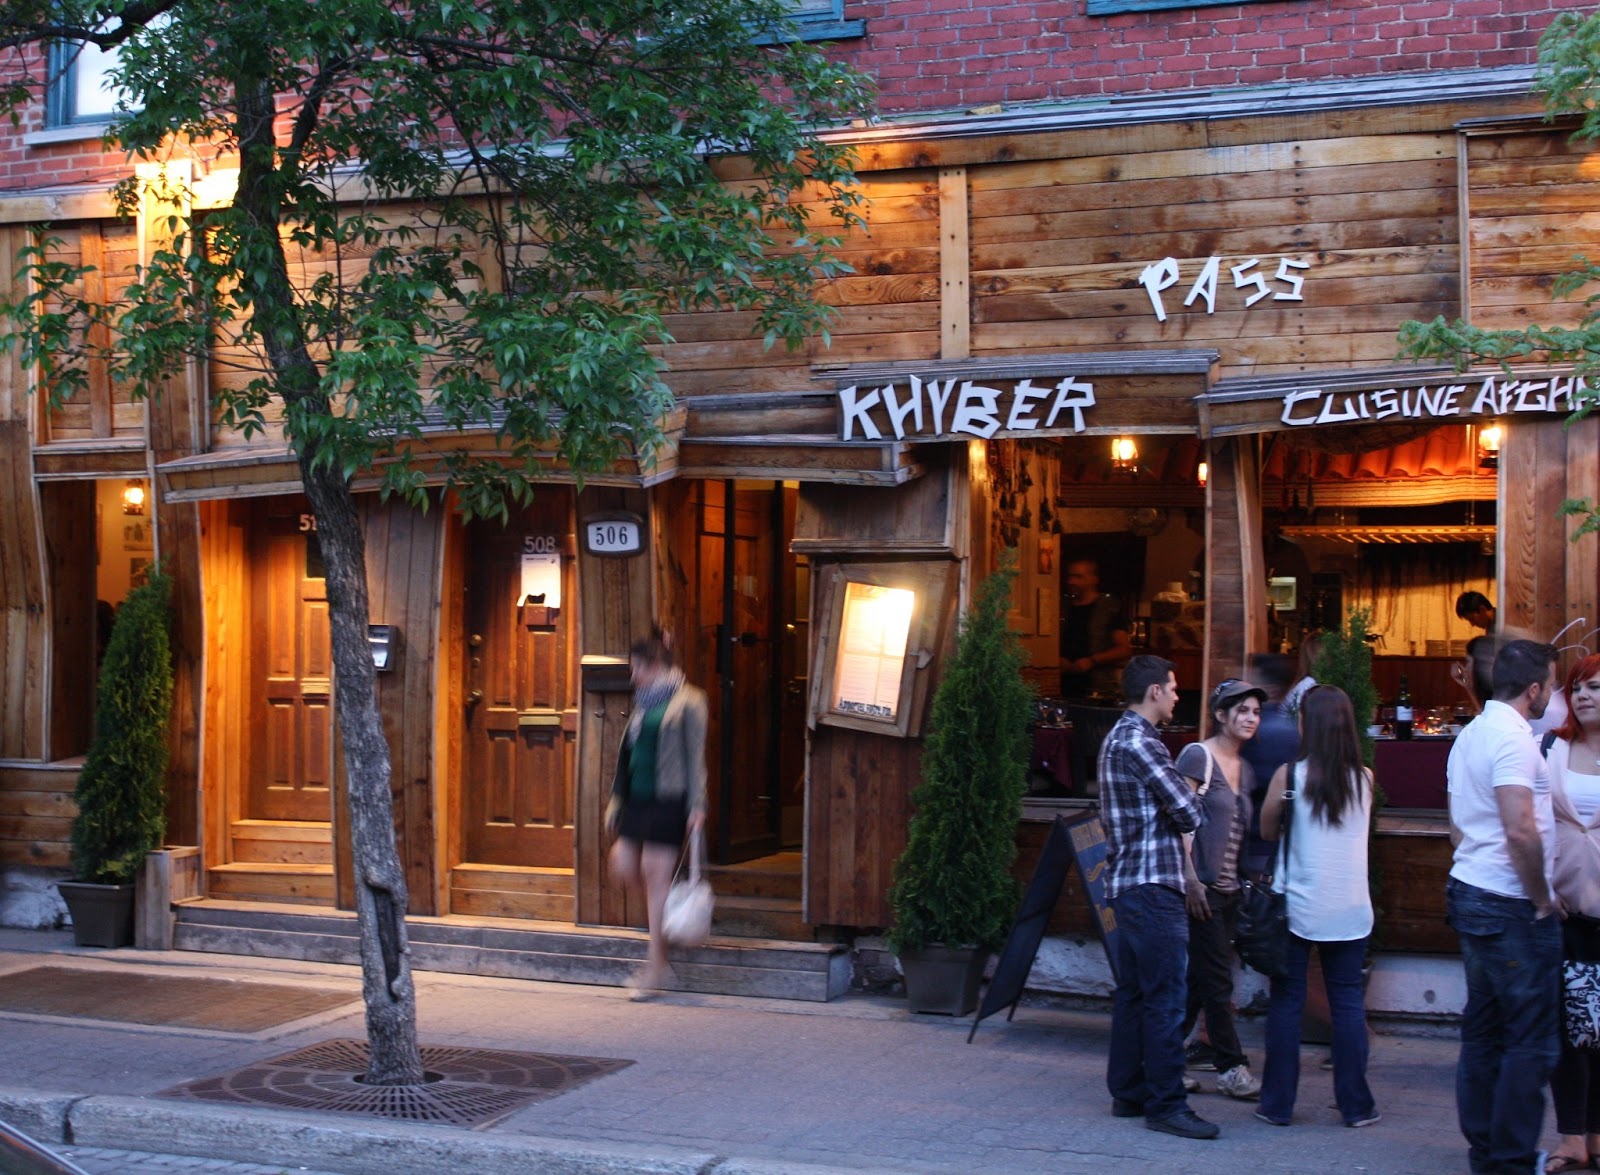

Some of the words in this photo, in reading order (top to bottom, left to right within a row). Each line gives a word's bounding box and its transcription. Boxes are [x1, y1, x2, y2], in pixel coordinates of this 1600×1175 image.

[1138, 256, 1311, 322] PASS
[838, 374, 1096, 441] KHYBER
[1280, 384, 1467, 427] CUISINE
[524, 535, 556, 554] 508
[595, 525, 628, 546] 506
